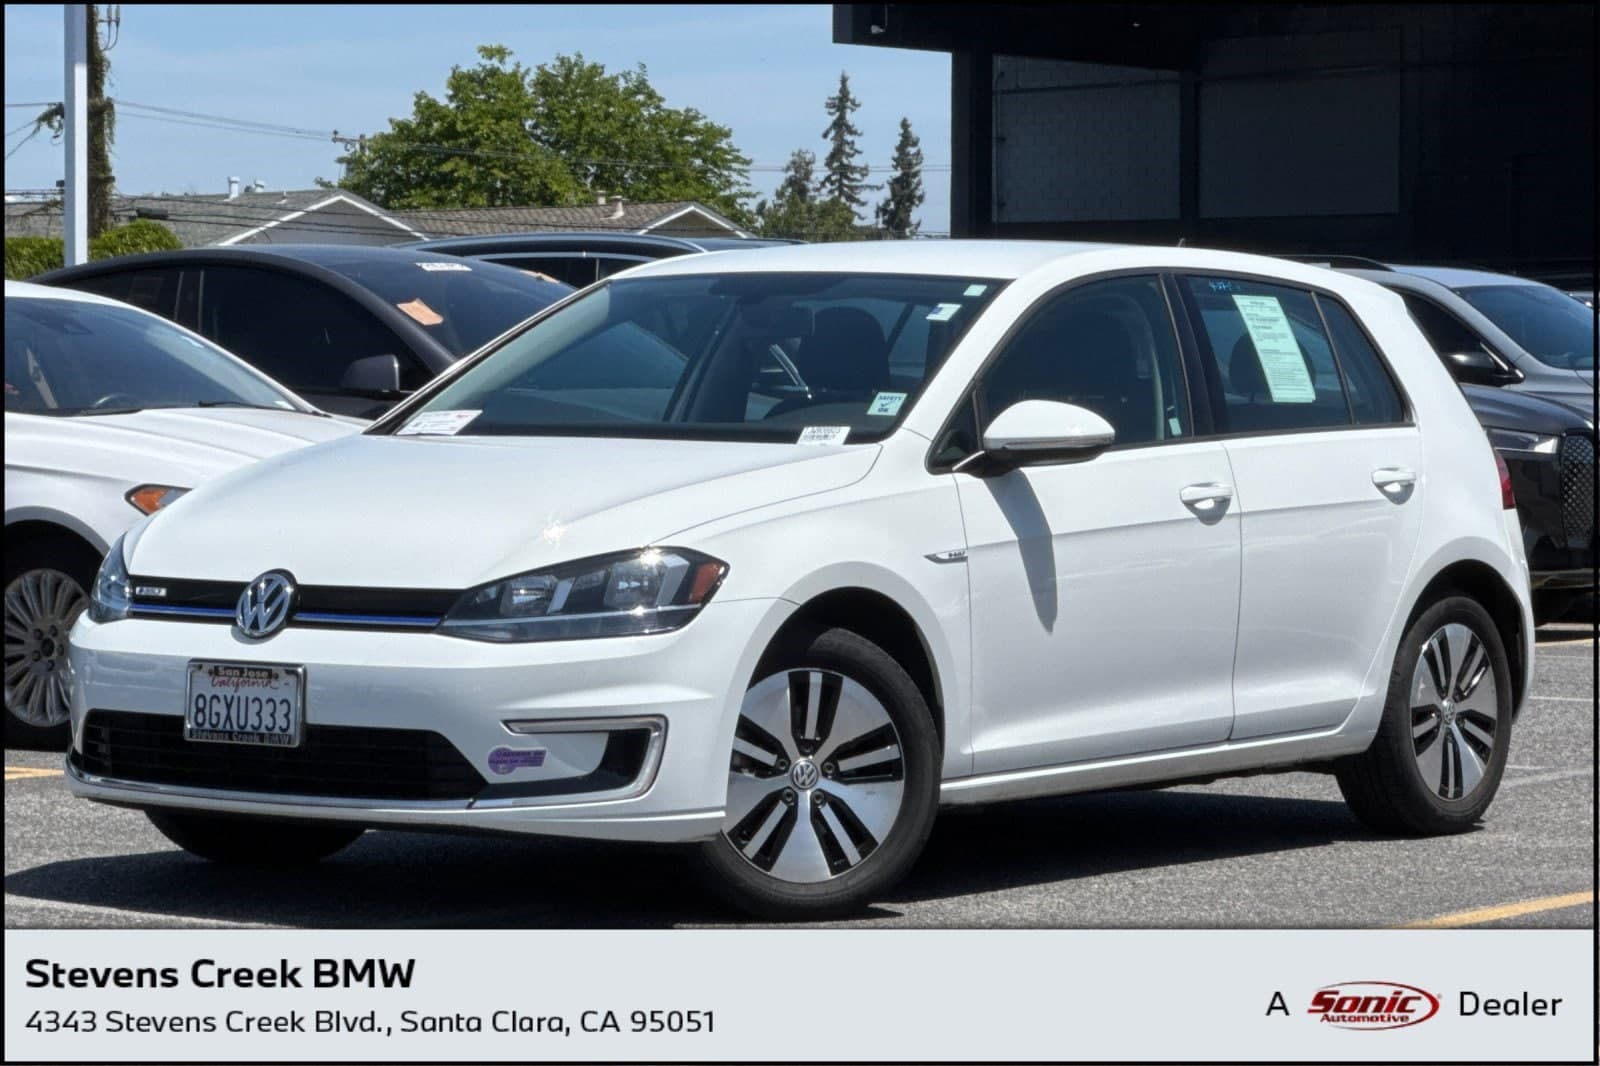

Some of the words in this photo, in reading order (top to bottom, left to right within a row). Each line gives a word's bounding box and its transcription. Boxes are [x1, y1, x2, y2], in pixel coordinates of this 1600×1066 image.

[218, 667, 240, 677] San
[242, 668, 269, 678] Jose
[211, 677, 278, 693] California
[194, 693, 291, 733] 8GXU333
